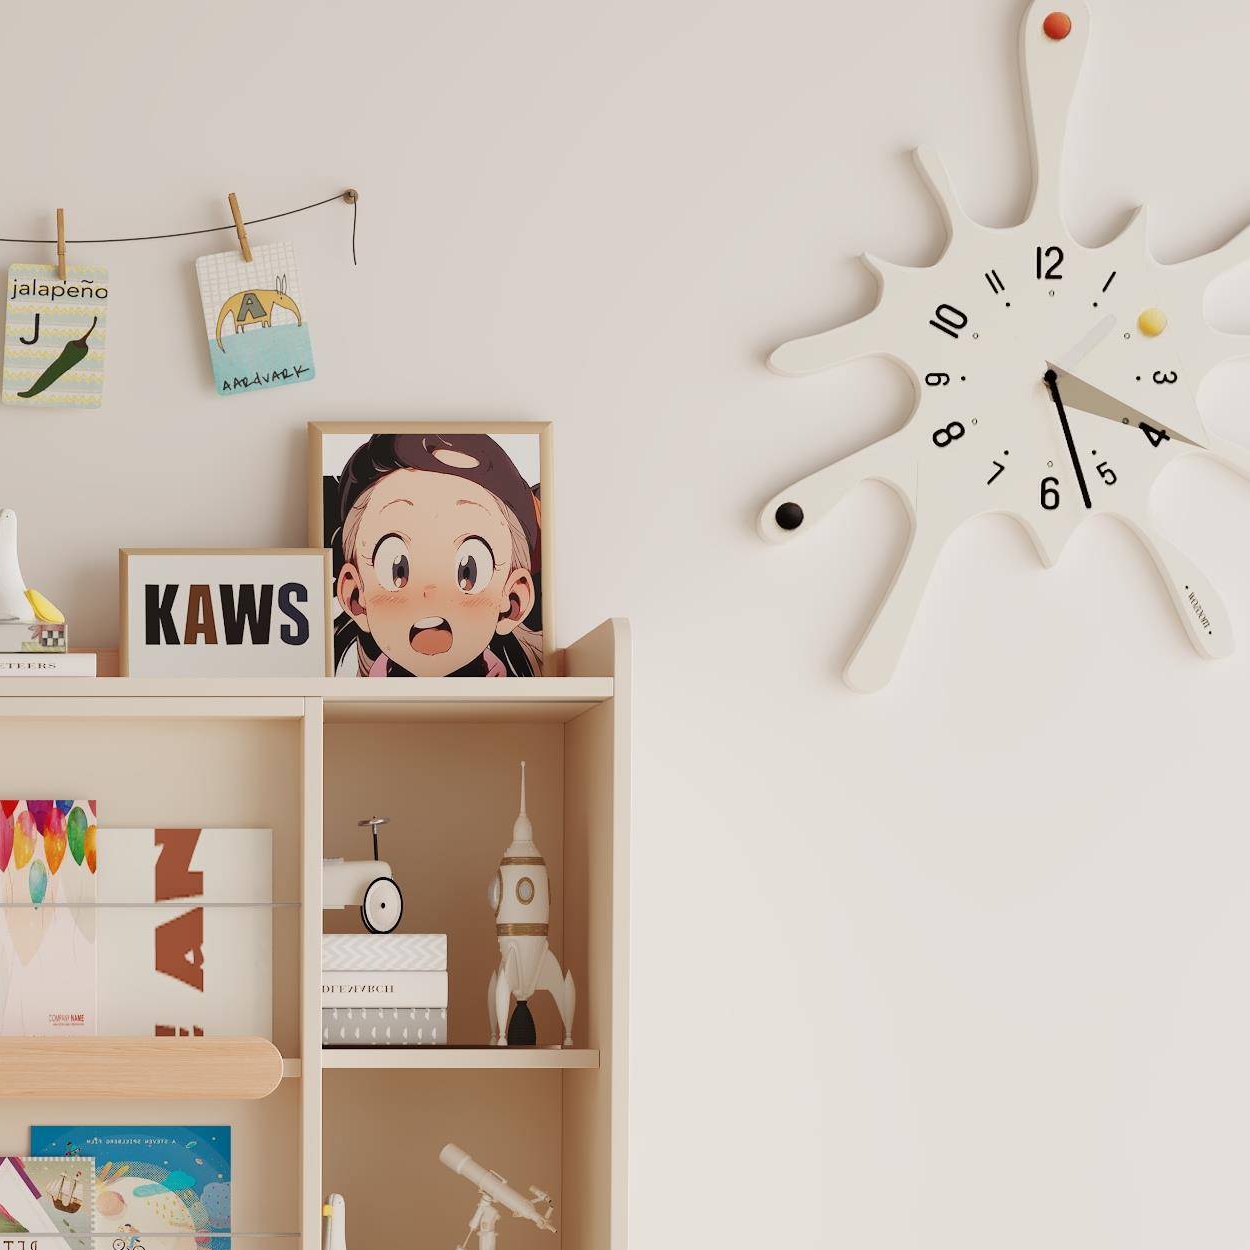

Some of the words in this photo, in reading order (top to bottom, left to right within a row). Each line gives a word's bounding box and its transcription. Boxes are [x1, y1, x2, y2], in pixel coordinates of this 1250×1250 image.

[1036, 246, 1064, 280] 12
[11, 279, 108, 300] jalapeño
[19, 313, 40, 345] J
[929, 303, 968, 339] 10
[924, 372, 950, 386] 9
[1152, 370, 1178, 384] 3
[932, 421, 966, 448] 8
[1138, 421, 1171, 448] 4
[986, 460, 1006, 486] 7
[1096, 460, 1118, 486] 5
[1040, 476, 1060, 510] 6
[145, 582, 310, 646] KAWS
